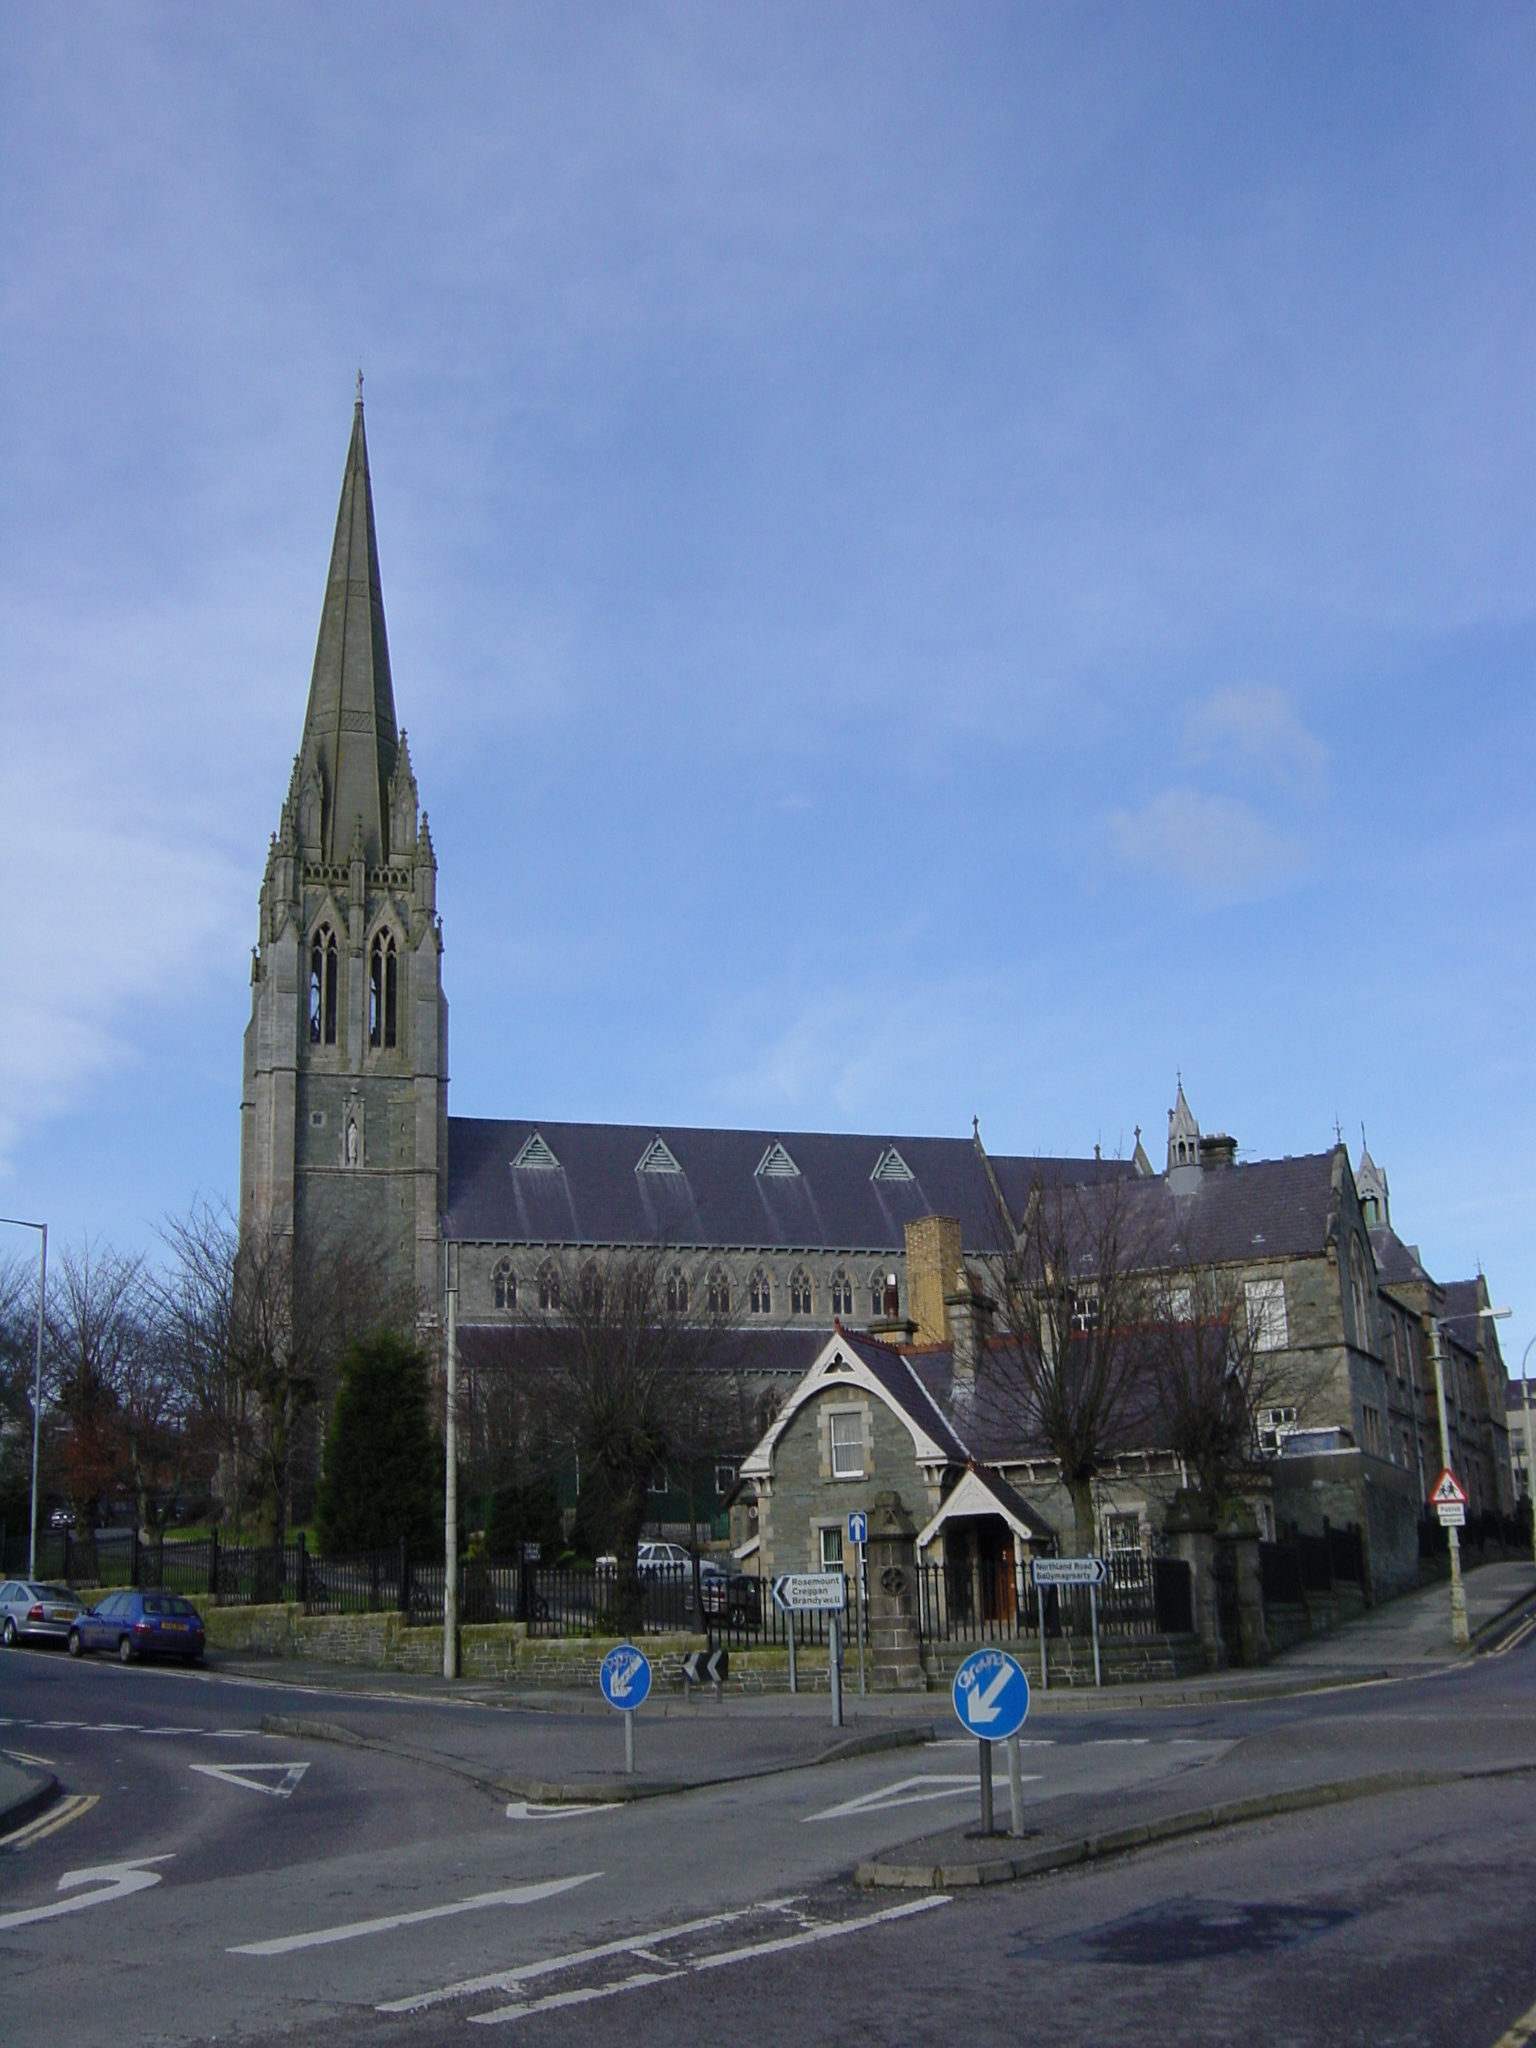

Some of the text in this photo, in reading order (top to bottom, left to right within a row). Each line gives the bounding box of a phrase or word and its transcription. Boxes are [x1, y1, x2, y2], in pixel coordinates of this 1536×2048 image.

[1036, 1562, 1092, 1570] Northland Road
[792, 1577, 840, 1586] Rosemount
[792, 1587, 828, 1596] Creggan
[792, 1596, 840, 1605] Brandywell
